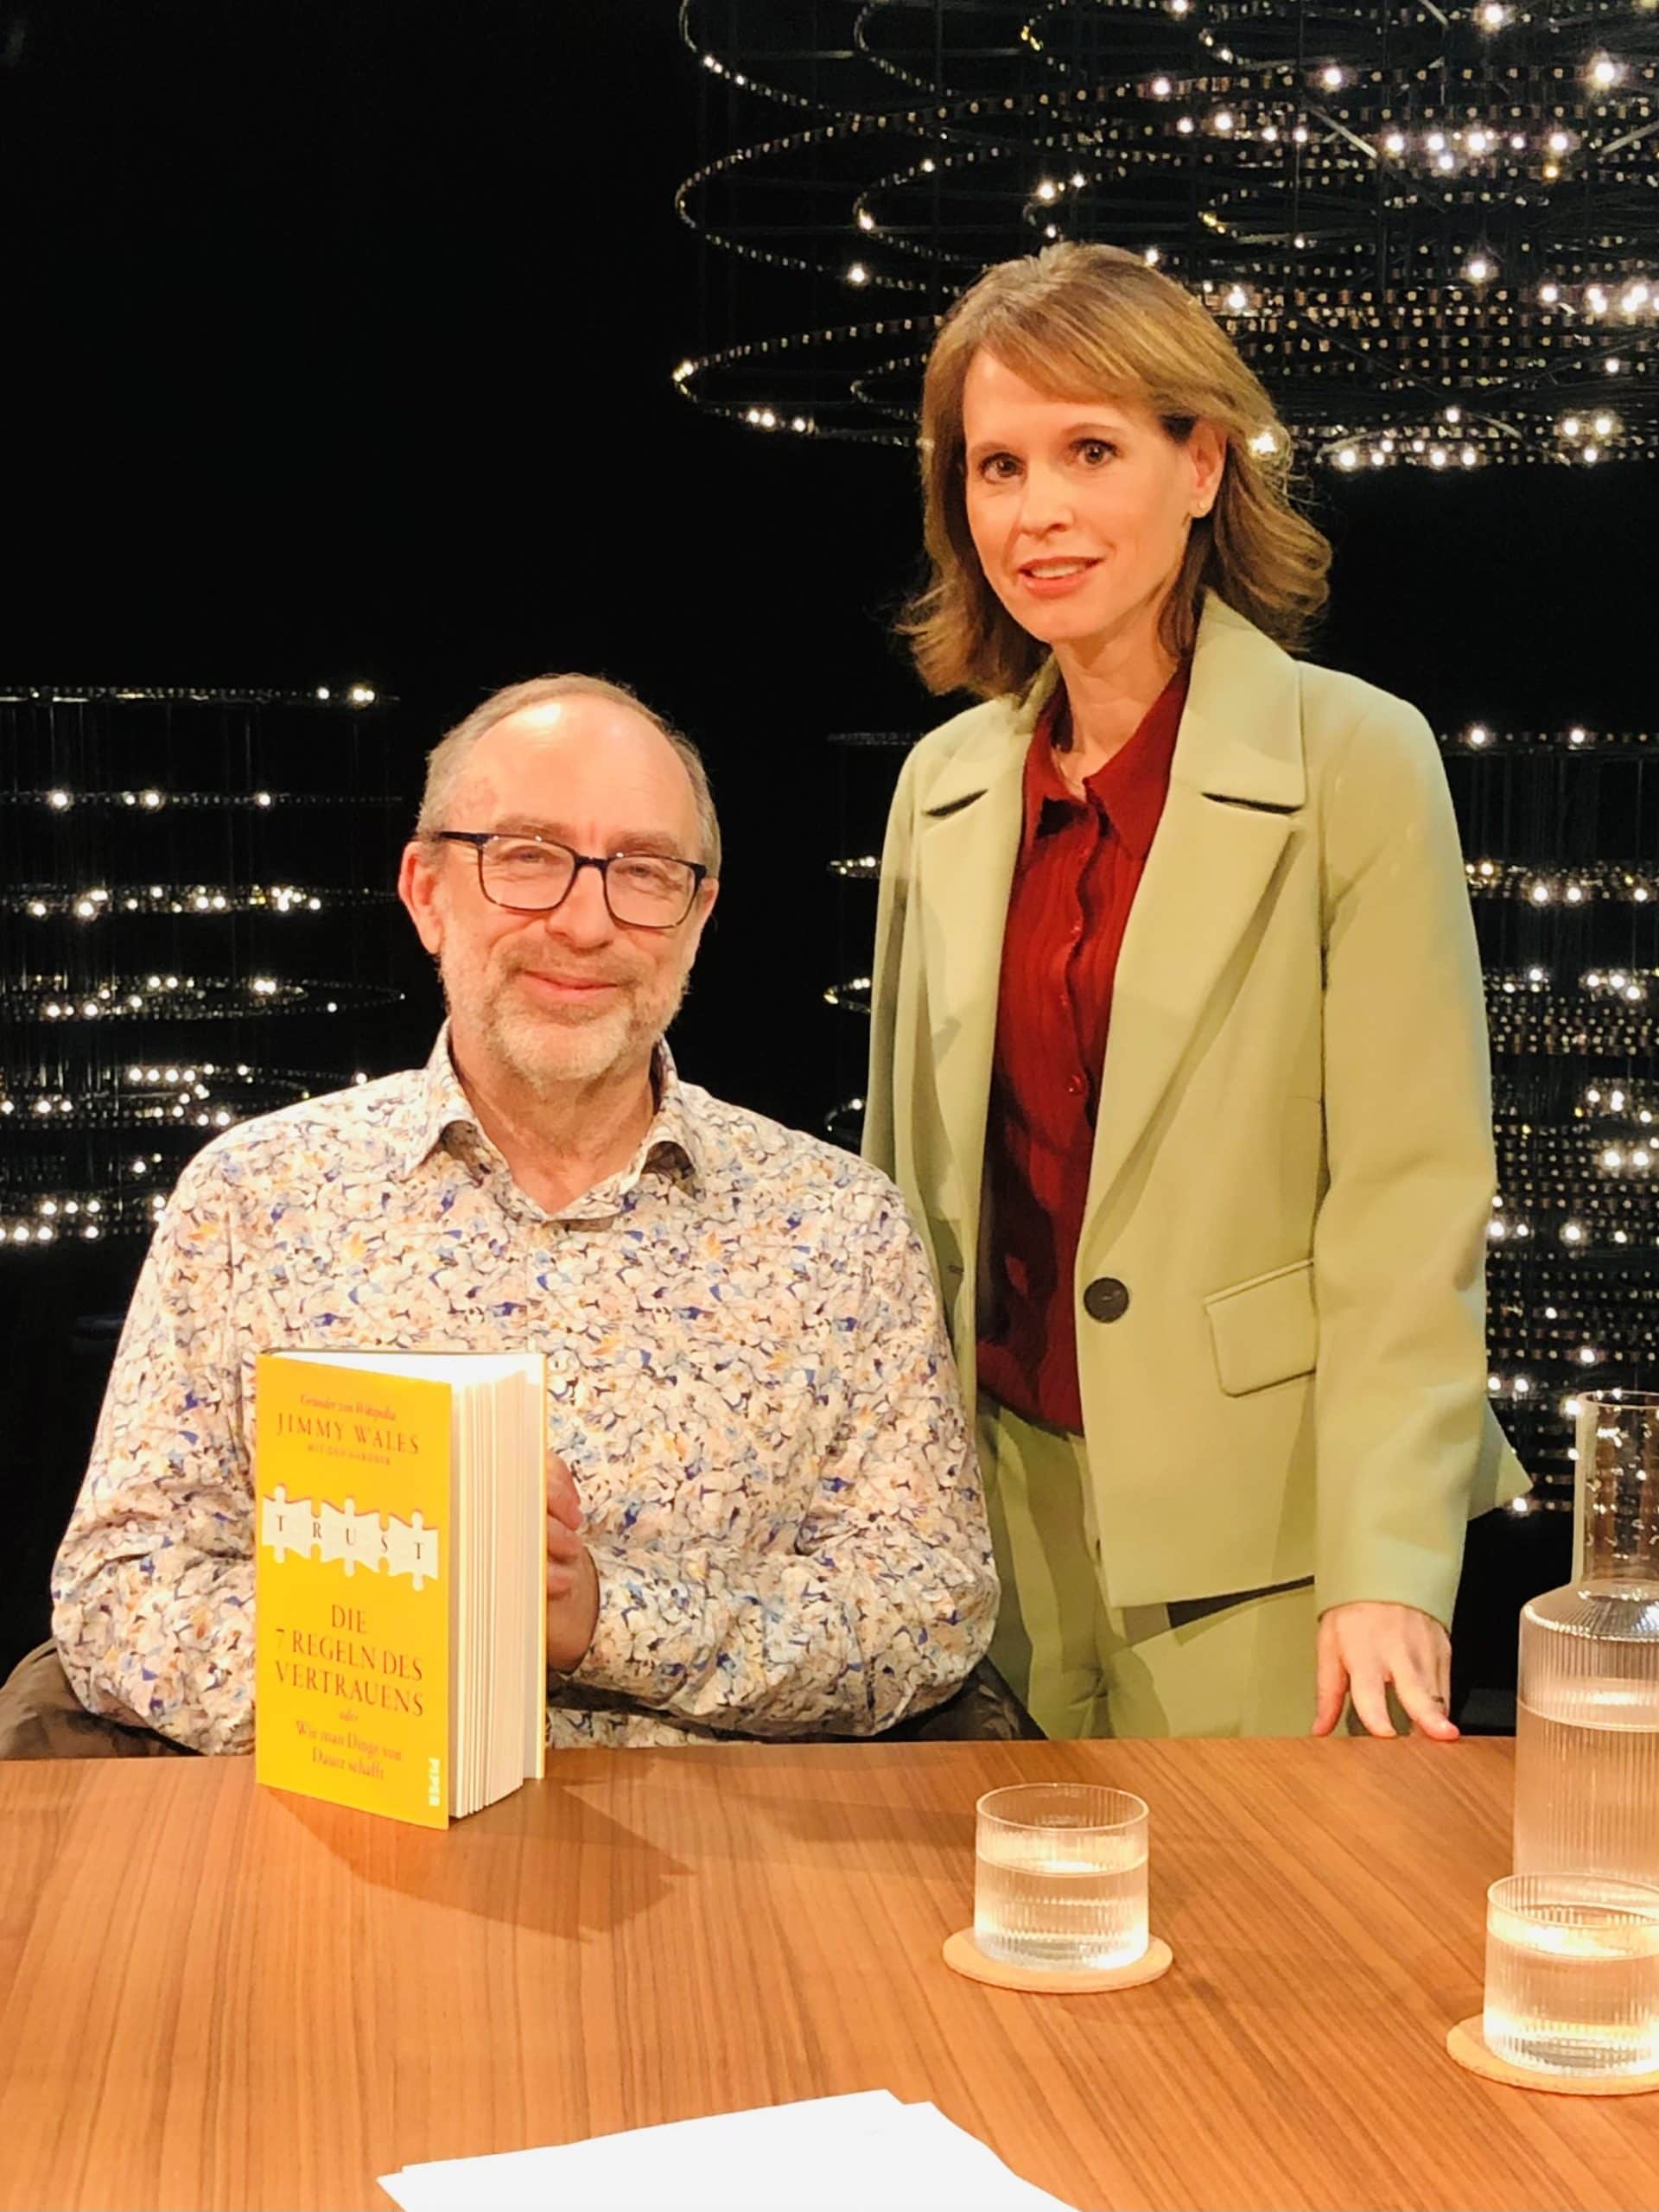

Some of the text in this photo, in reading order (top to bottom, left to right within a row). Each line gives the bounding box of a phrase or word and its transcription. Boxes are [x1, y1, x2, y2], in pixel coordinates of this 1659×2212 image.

[276, 1413, 420, 1454] JIMMY WALES
[276, 1514, 425, 1560] TRUST
[331, 1603, 367, 1634] DIE
[292, 1630, 376, 1670] REGELN
[383, 1649, 423, 1681] DES
[275, 1660, 424, 1717] VERTRAUENS
